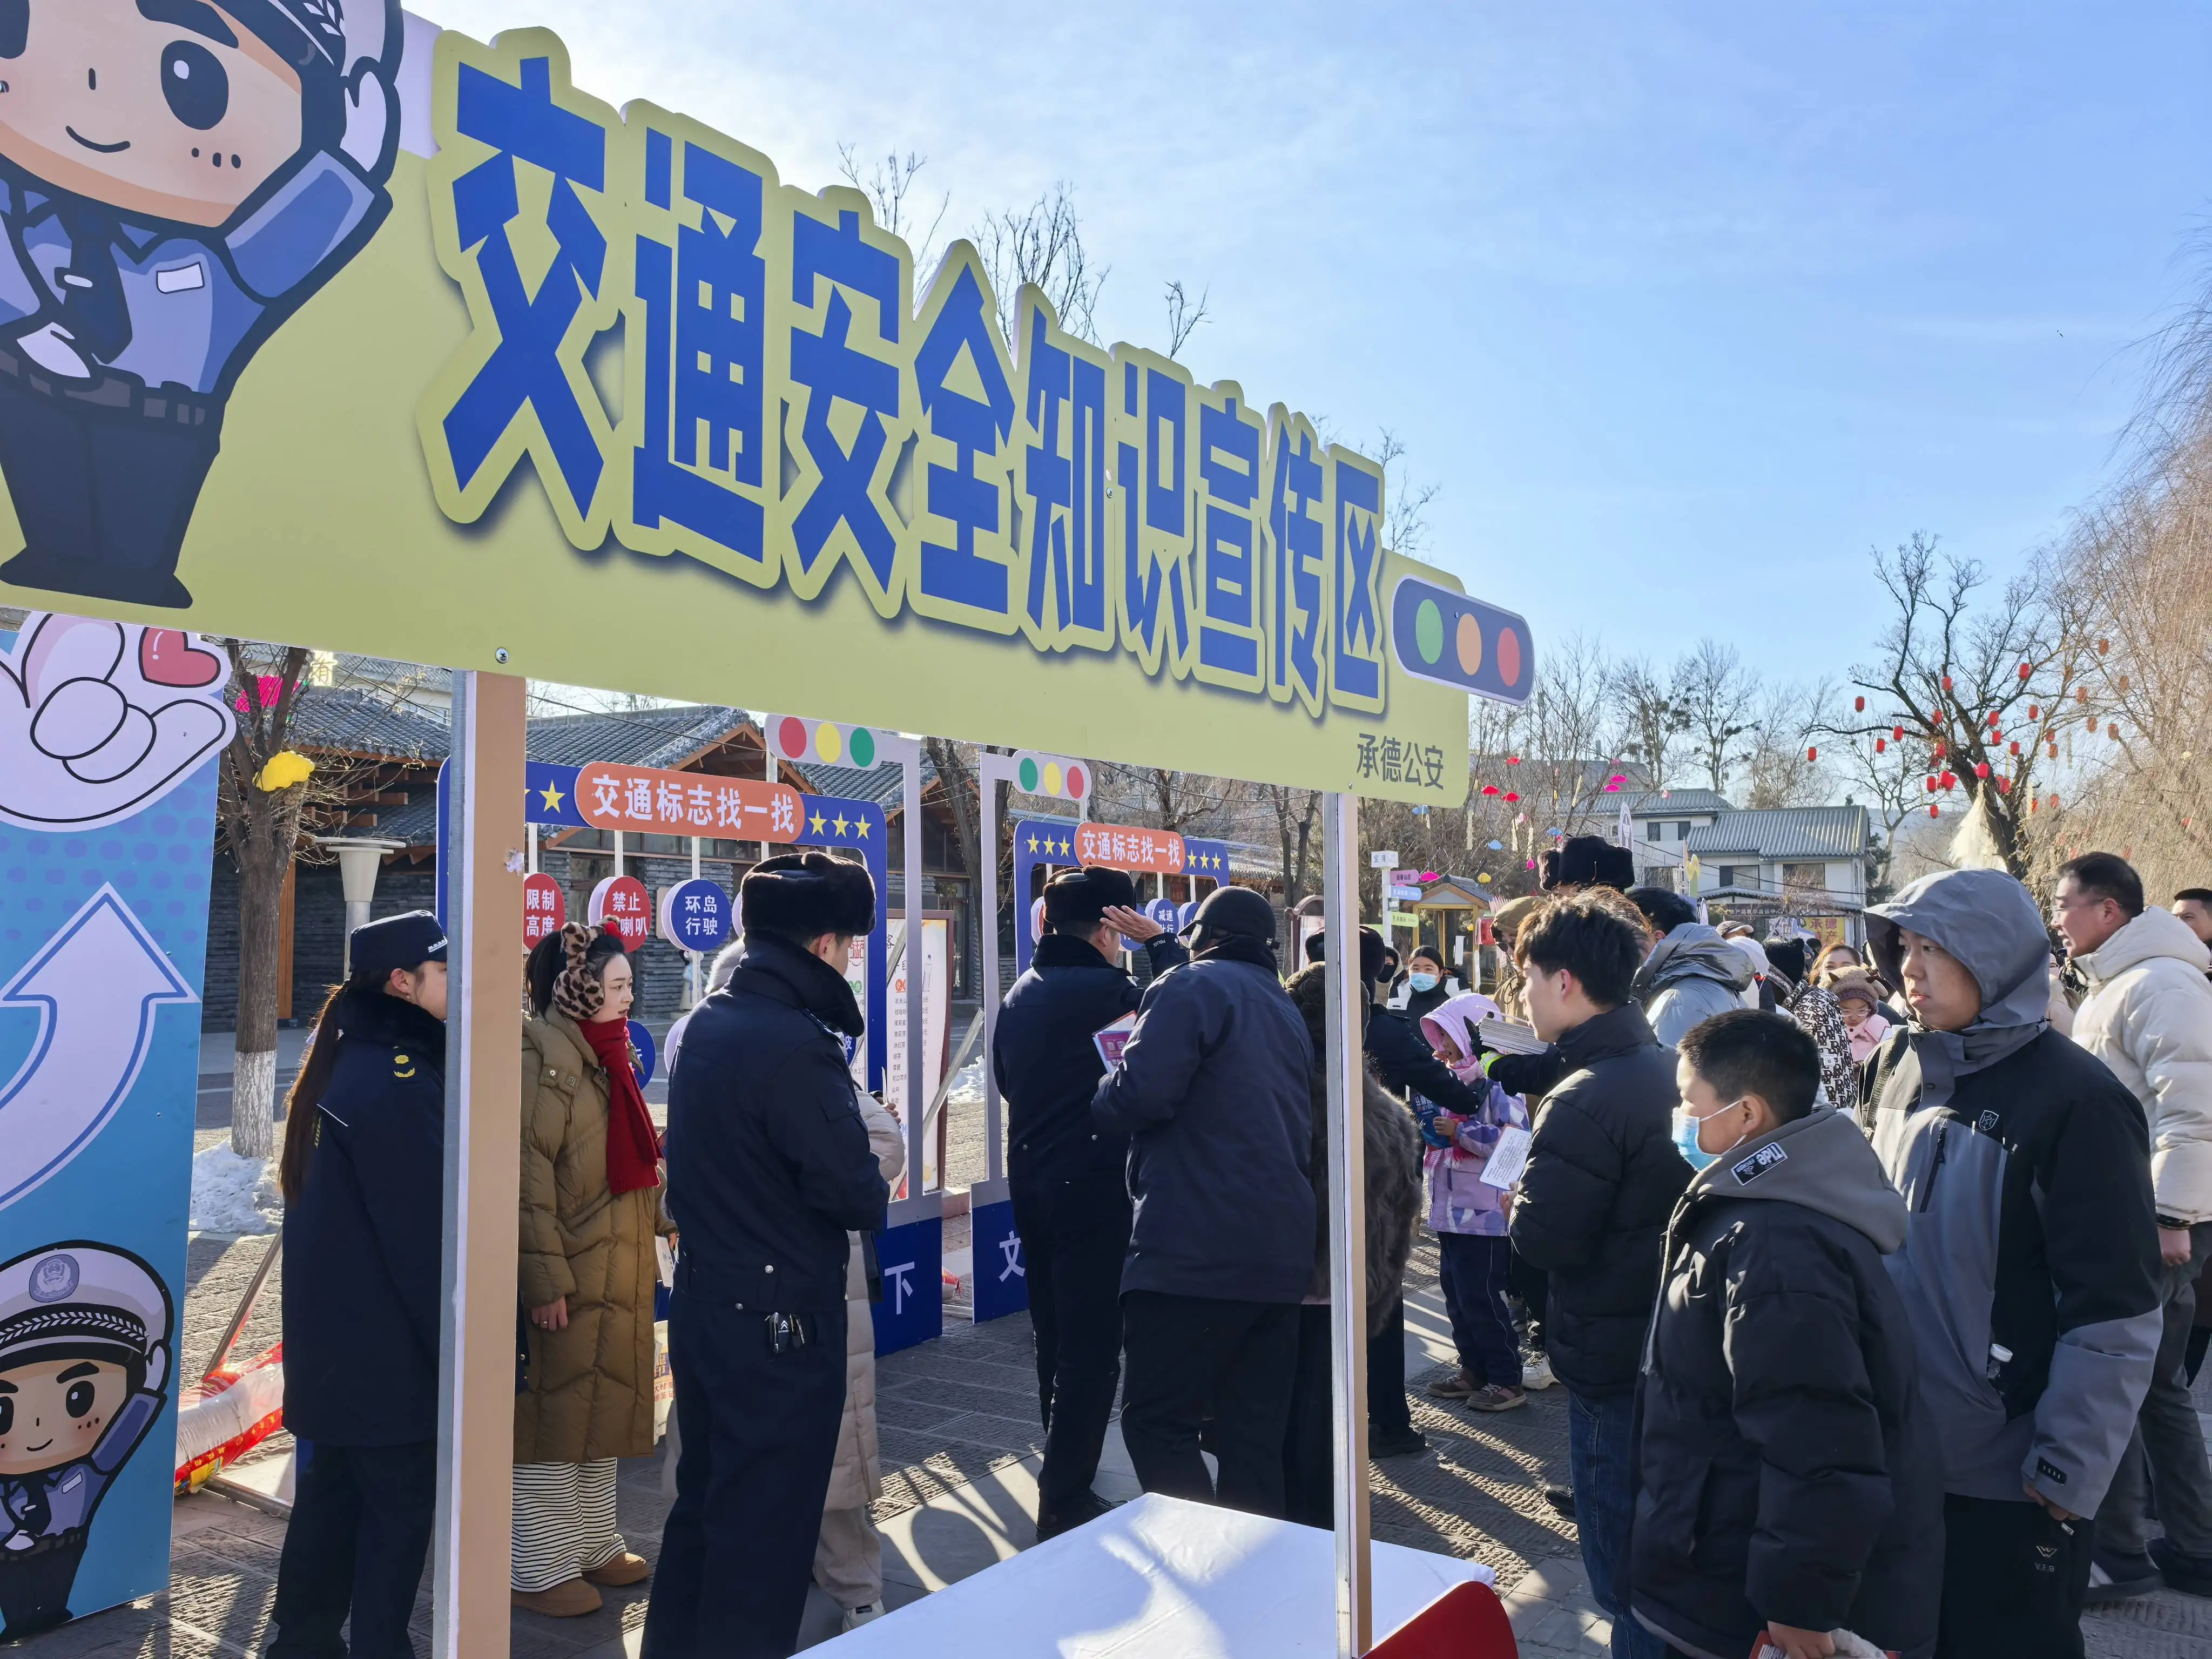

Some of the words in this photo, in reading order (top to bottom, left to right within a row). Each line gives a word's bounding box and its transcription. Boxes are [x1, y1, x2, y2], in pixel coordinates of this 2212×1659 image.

[443, 56, 1378, 701] 交通安全知识宣传区
[1357, 733, 1444, 790] 承德公安
[592, 774, 794, 834] 交通标志找一找
[1082, 830, 1181, 866] 交通标志找一找
[527, 889, 555, 911] 限制
[612, 891, 640, 912] 禁止
[685, 895, 717, 914] 环岛
[526, 915, 555, 937] 高度
[1158, 909, 1173, 921] 减速
[1810, 918, 1837, 929] 承德
[619, 917, 648, 936] 喇叭
[685, 918, 718, 936] 行驶
[1153, 939, 1165, 947] POLICE
[999, 1230, 1026, 1282] 文
[885, 1262, 915, 1314] 下
